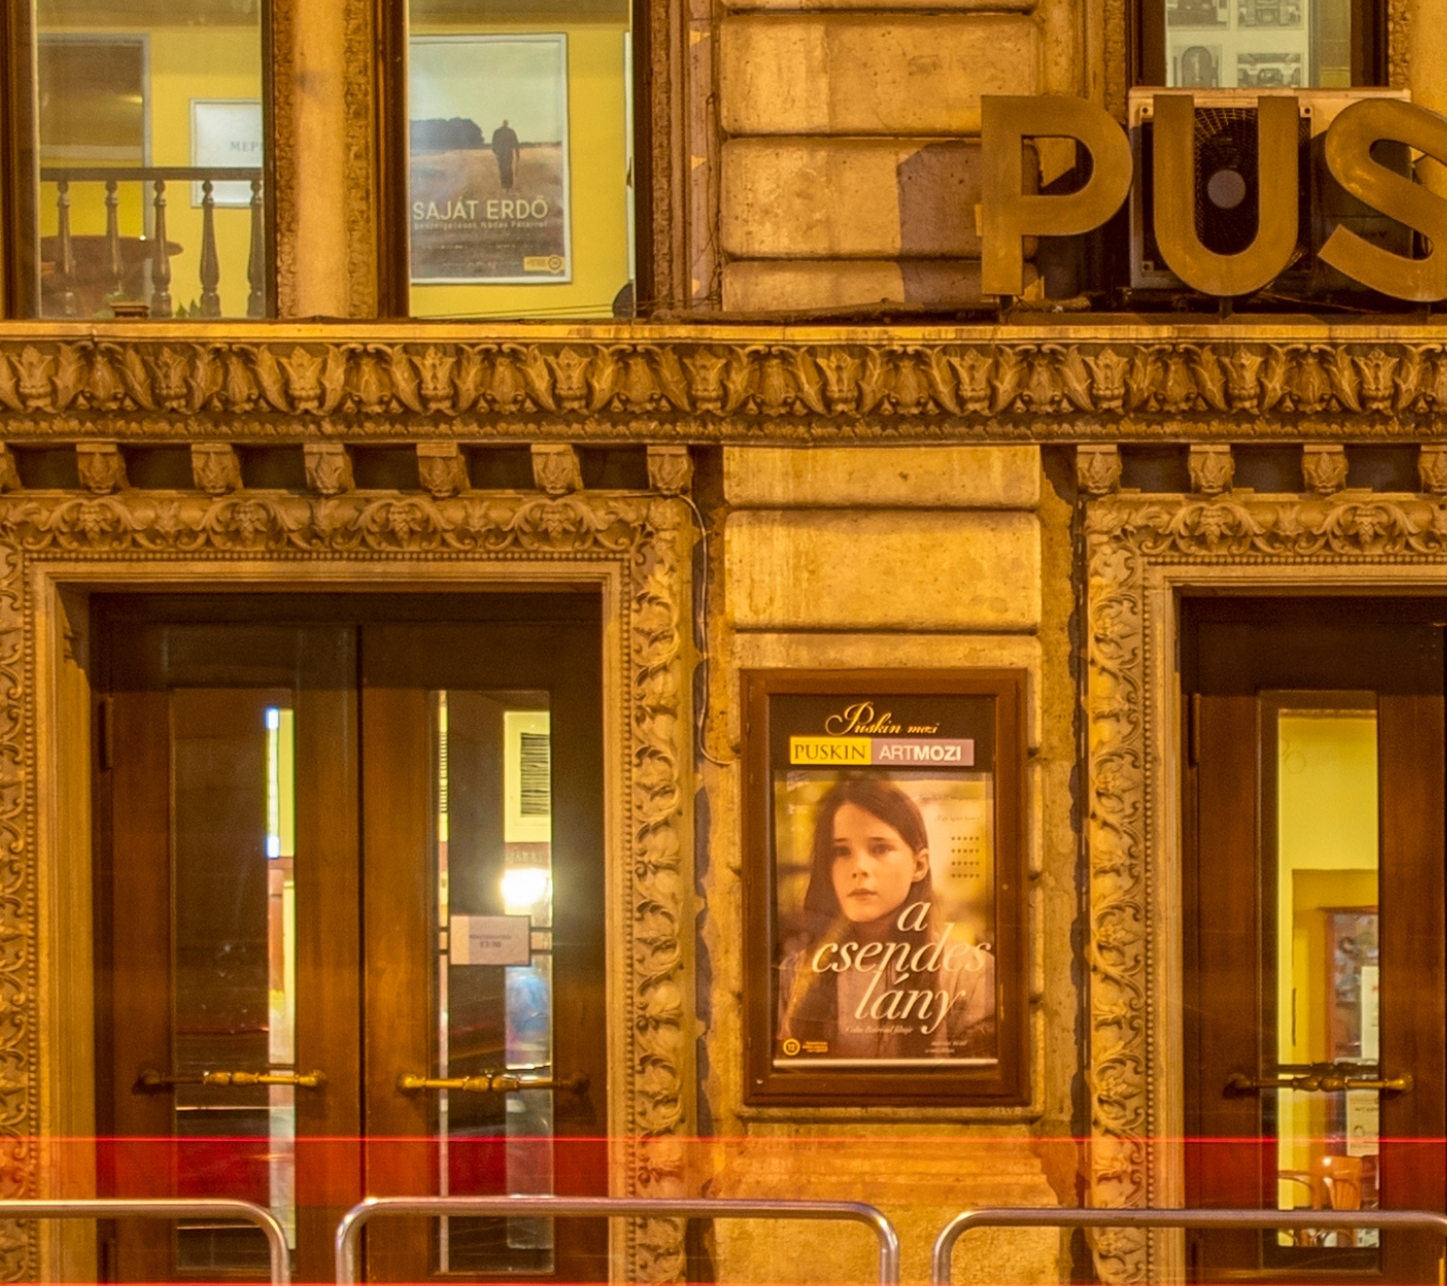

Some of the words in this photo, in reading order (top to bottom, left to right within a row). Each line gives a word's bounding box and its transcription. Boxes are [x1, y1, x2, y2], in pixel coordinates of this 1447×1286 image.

[413, 197, 479, 221] SAJÁT
[486, 195, 549, 220] ERDŐ
[824, 701, 904, 736] Puskin
[906, 722, 941, 735] mozi
[794, 743, 866, 761] PUSKIN
[878, 744, 962, 762] ARTMOZI
[897, 901, 931, 932] a
[811, 922, 992, 973] csendes
[854, 970, 967, 1035] lány
